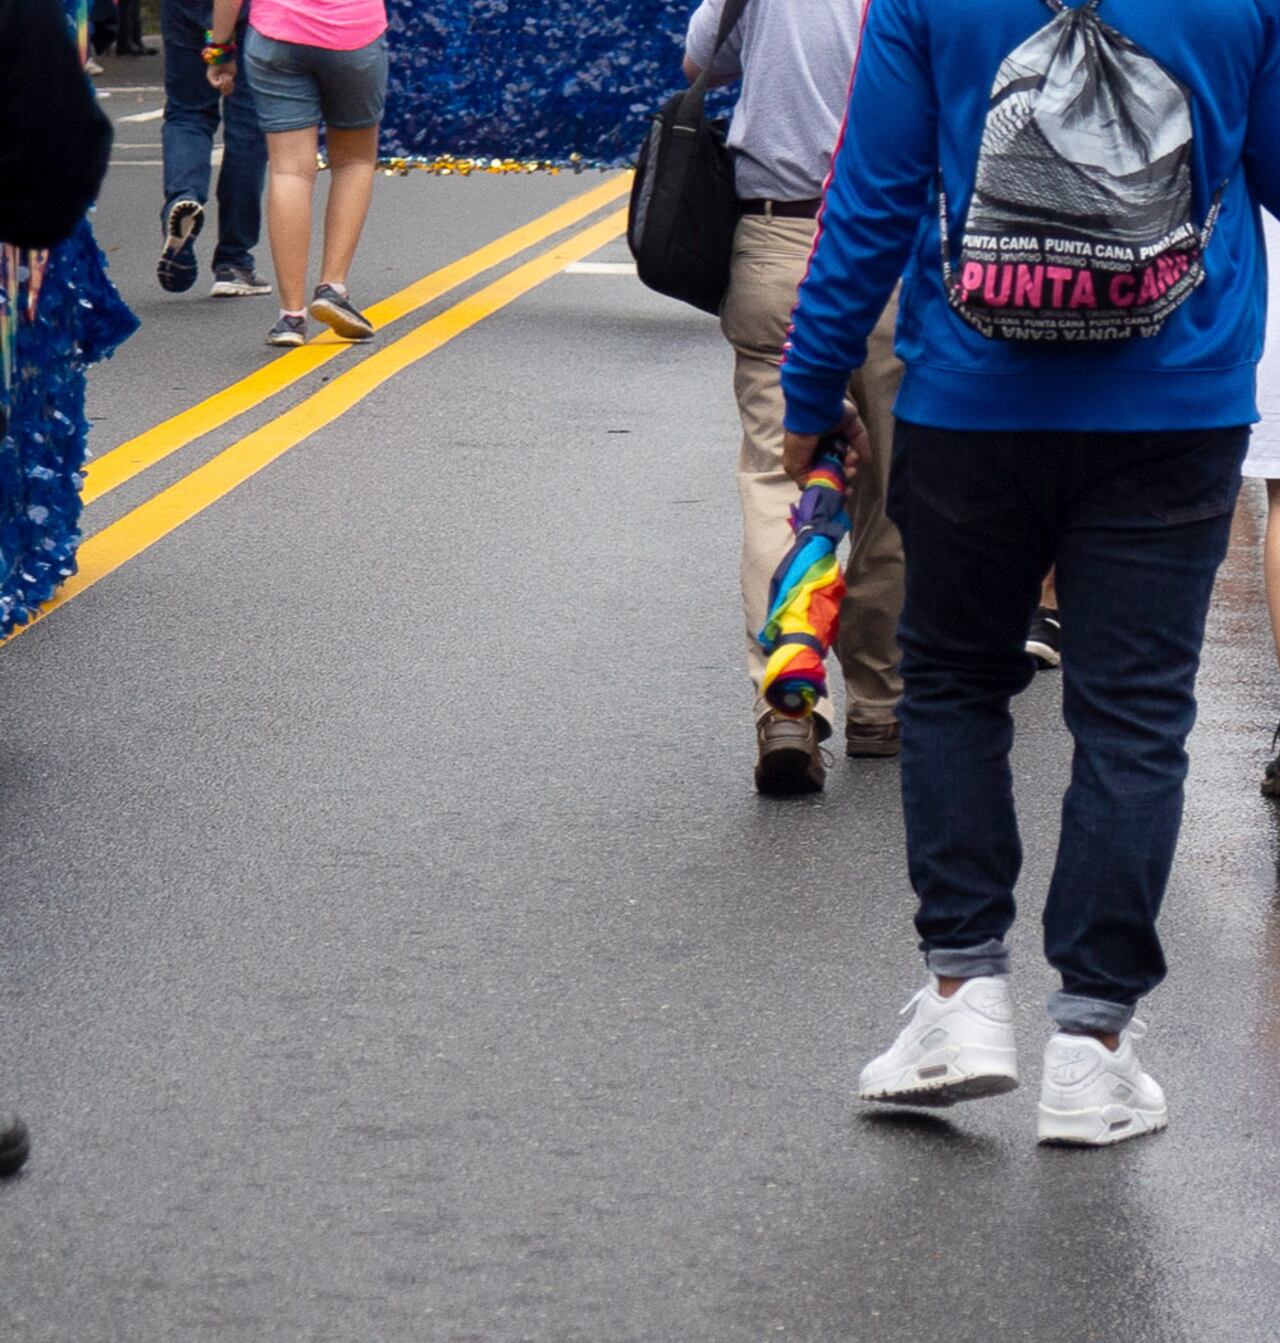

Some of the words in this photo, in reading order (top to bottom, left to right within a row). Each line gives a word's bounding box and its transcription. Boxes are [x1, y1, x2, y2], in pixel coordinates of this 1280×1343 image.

[962, 234, 997, 250] PUNTA
[1000, 236, 1039, 250] CANA
[1045, 238, 1092, 256] PUNTA
[1095, 243, 1134, 260] CANA
[961, 261, 1097, 309] PUNTA
[1109, 254, 1189, 308] CANA
[1024, 318, 1056, 328] PUNTA
[1123, 316, 1150, 326] CANA
[1002, 326, 1057, 341] CANA
[1063, 327, 1131, 340] PUNTA
